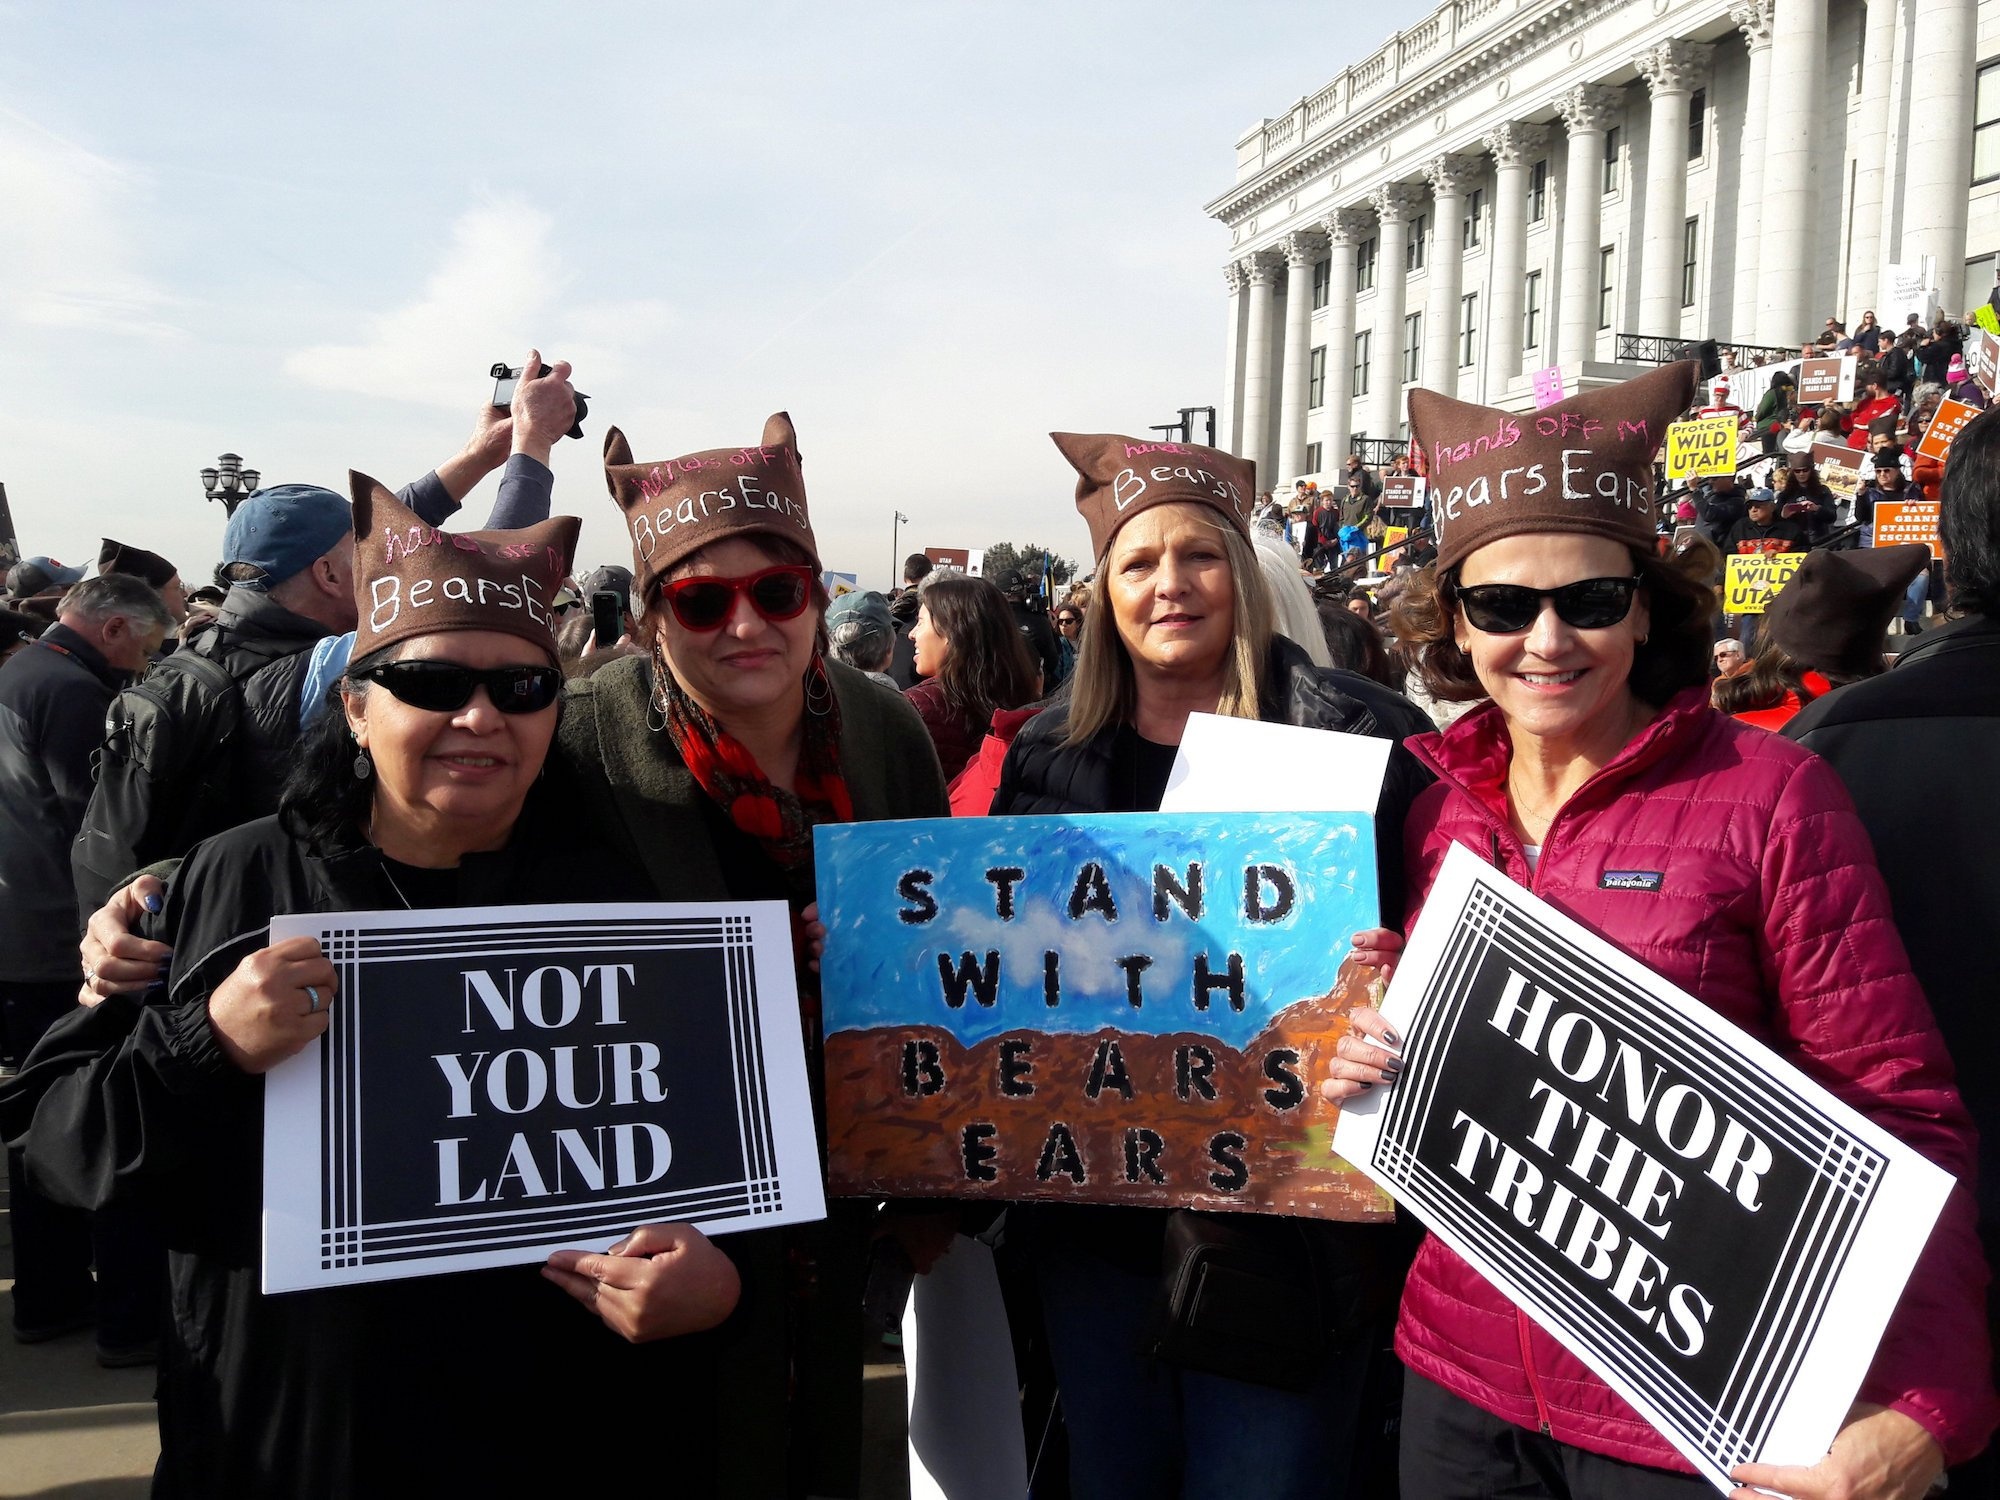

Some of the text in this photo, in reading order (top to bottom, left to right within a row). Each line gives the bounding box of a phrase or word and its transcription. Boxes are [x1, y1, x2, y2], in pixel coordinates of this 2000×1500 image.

[1435, 417, 1521, 475] hands
[1536, 412, 1603, 440] OFF
[1672, 420, 1733, 435] Protect
[1677, 432, 1727, 451] WILD
[1674, 449, 1728, 470] UTAH
[1731, 556, 1803, 567] Protect
[1737, 568, 1793, 584] WILD
[1732, 588, 1780, 604] UTA
[898, 863, 1296, 925] STAND
[1605, 879, 1653, 888] patagonia
[460, 963, 636, 1033] NOT
[938, 950, 1245, 1012] WITH
[431, 1041, 668, 1119] YOUR
[902, 1037, 1305, 1111] BEARS
[1487, 966, 1774, 1213] HONOR
[433, 1122, 673, 1207] LAND
[961, 1122, 1249, 1192] EARS
[1525, 1077, 1685, 1242] THE
[1450, 1110, 1714, 1358] TRIBES
